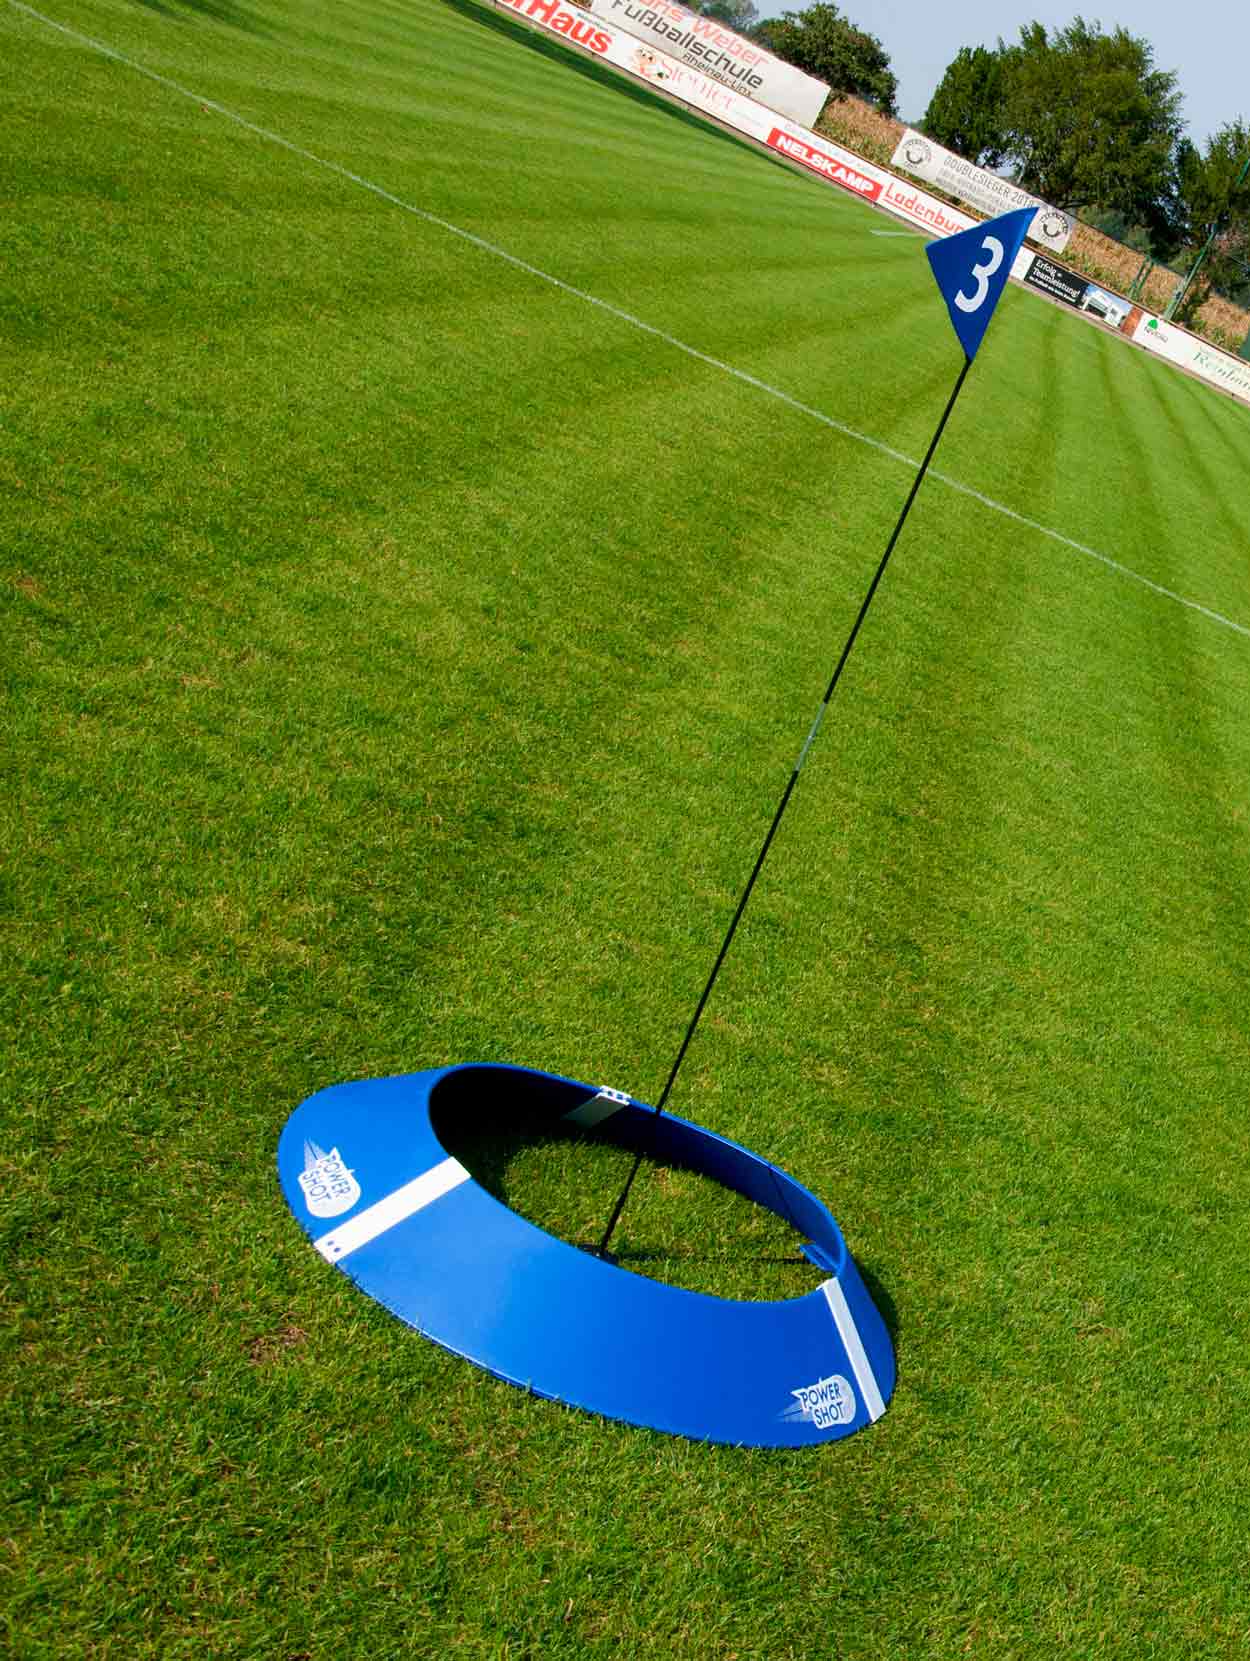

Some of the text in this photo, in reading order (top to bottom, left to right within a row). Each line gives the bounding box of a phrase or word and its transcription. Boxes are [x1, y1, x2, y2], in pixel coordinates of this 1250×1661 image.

[499, 0, 612, 54] Haus
[692, 18, 768, 66] Weber
[777, 135, 875, 193] NELSKAMP
[954, 236, 1004, 312] 3
[302, 1170, 332, 1202] SHOT
[318, 1153, 352, 1198] POWER
[799, 1381, 842, 1409] POWER
[814, 1401, 844, 1426] SHOT
